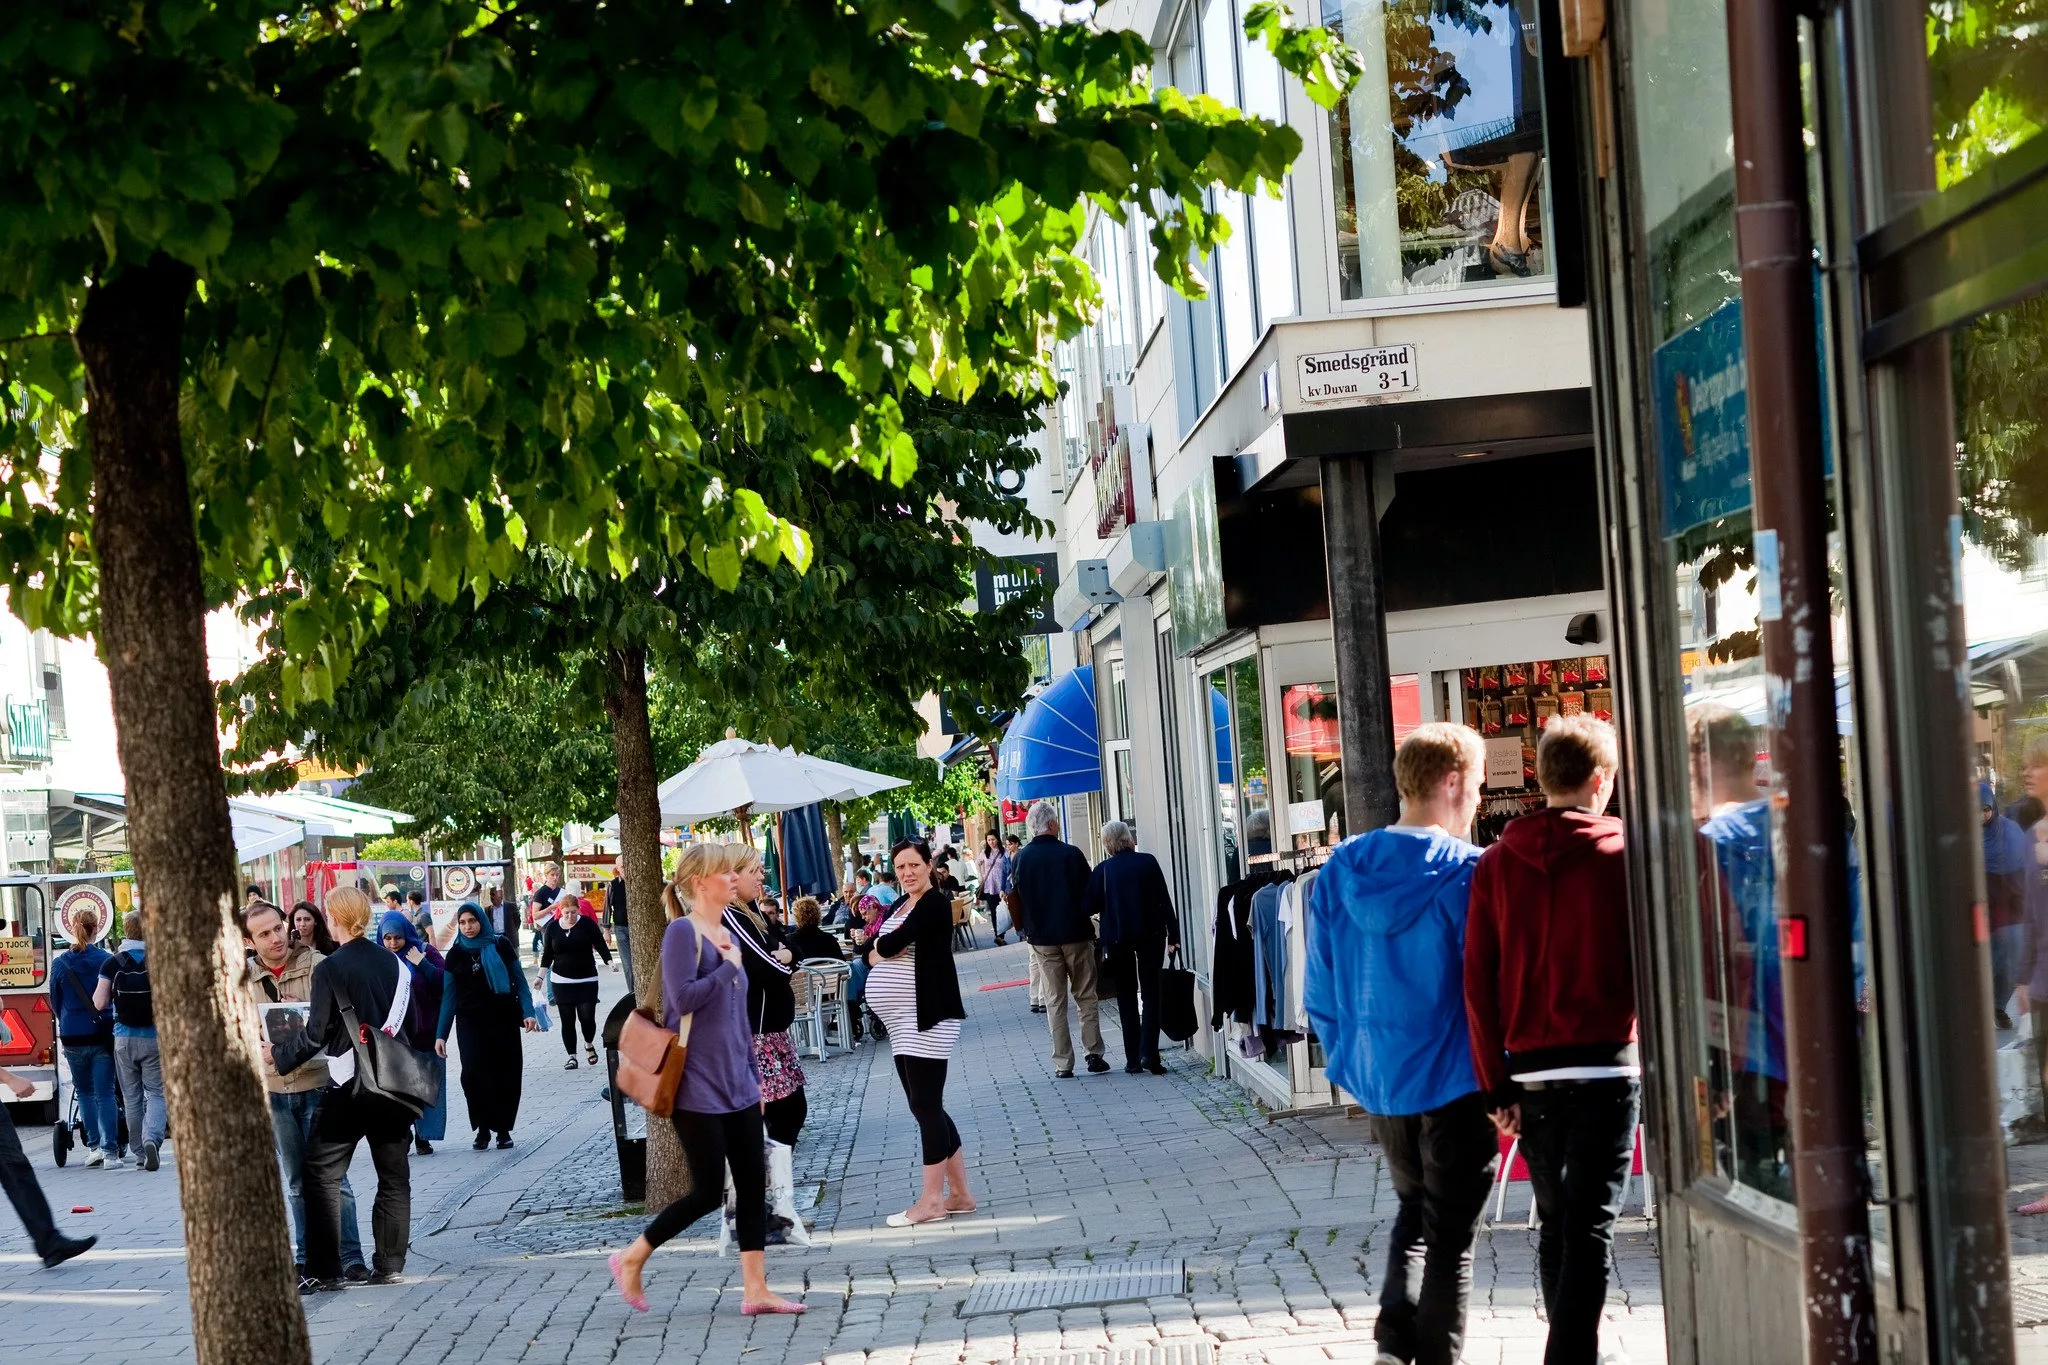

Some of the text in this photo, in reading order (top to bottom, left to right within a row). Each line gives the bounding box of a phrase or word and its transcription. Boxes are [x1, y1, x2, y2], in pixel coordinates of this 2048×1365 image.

[1305, 347, 1409, 374] Smedsgränd
[1379, 370, 1410, 389] 3-1
[1324, 384, 1358, 395] Duvan
[5, 940, 30, 949] TJOCK
